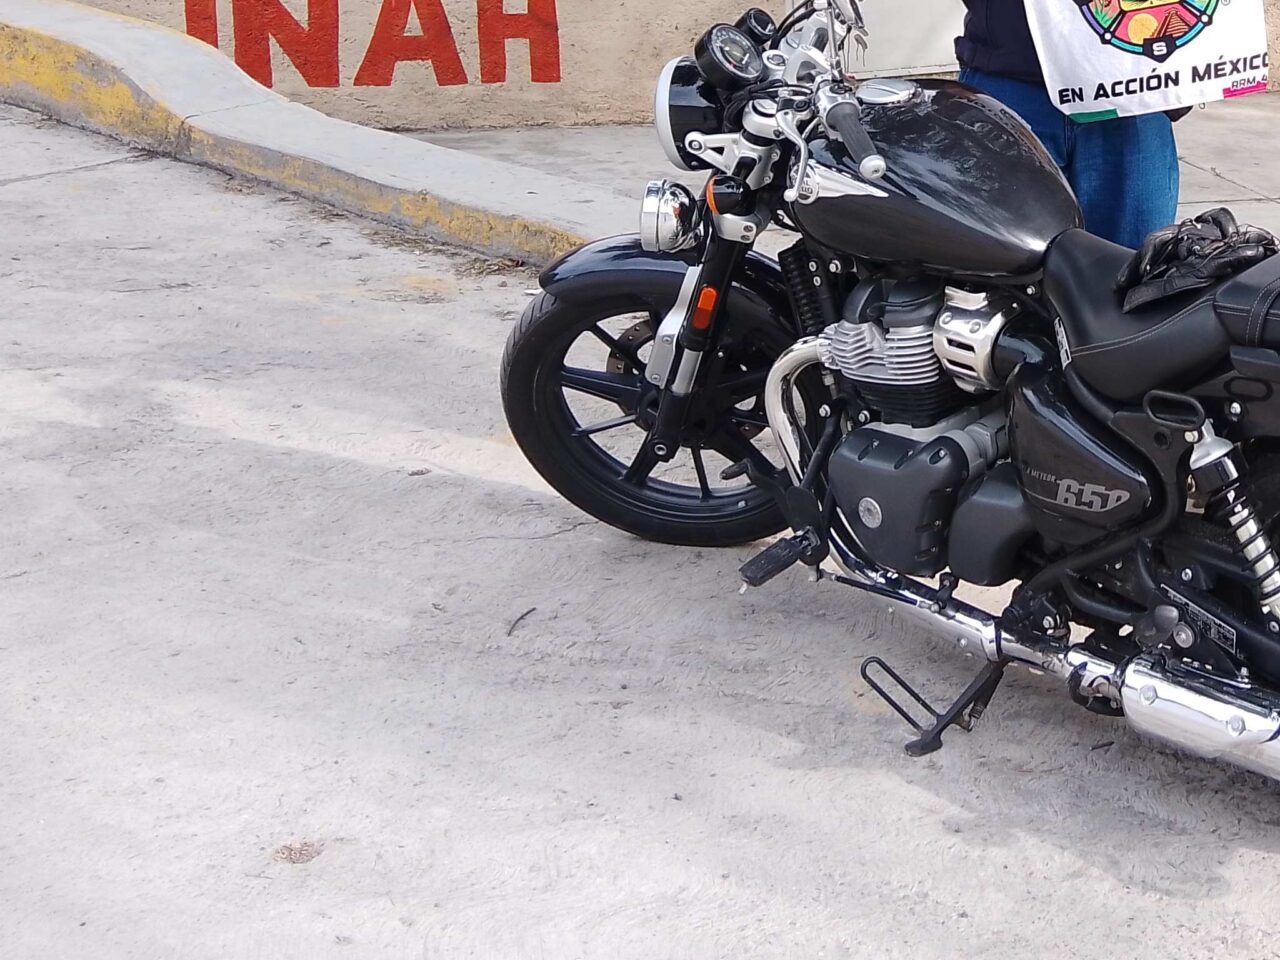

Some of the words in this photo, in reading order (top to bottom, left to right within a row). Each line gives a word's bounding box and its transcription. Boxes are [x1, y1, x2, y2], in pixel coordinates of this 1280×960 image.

[1152, 41, 1168, 55] S
[1057, 87, 1085, 105] EN
[1093, 67, 1180, 101] ACCIÓN
[1056, 478, 1131, 512] 650
